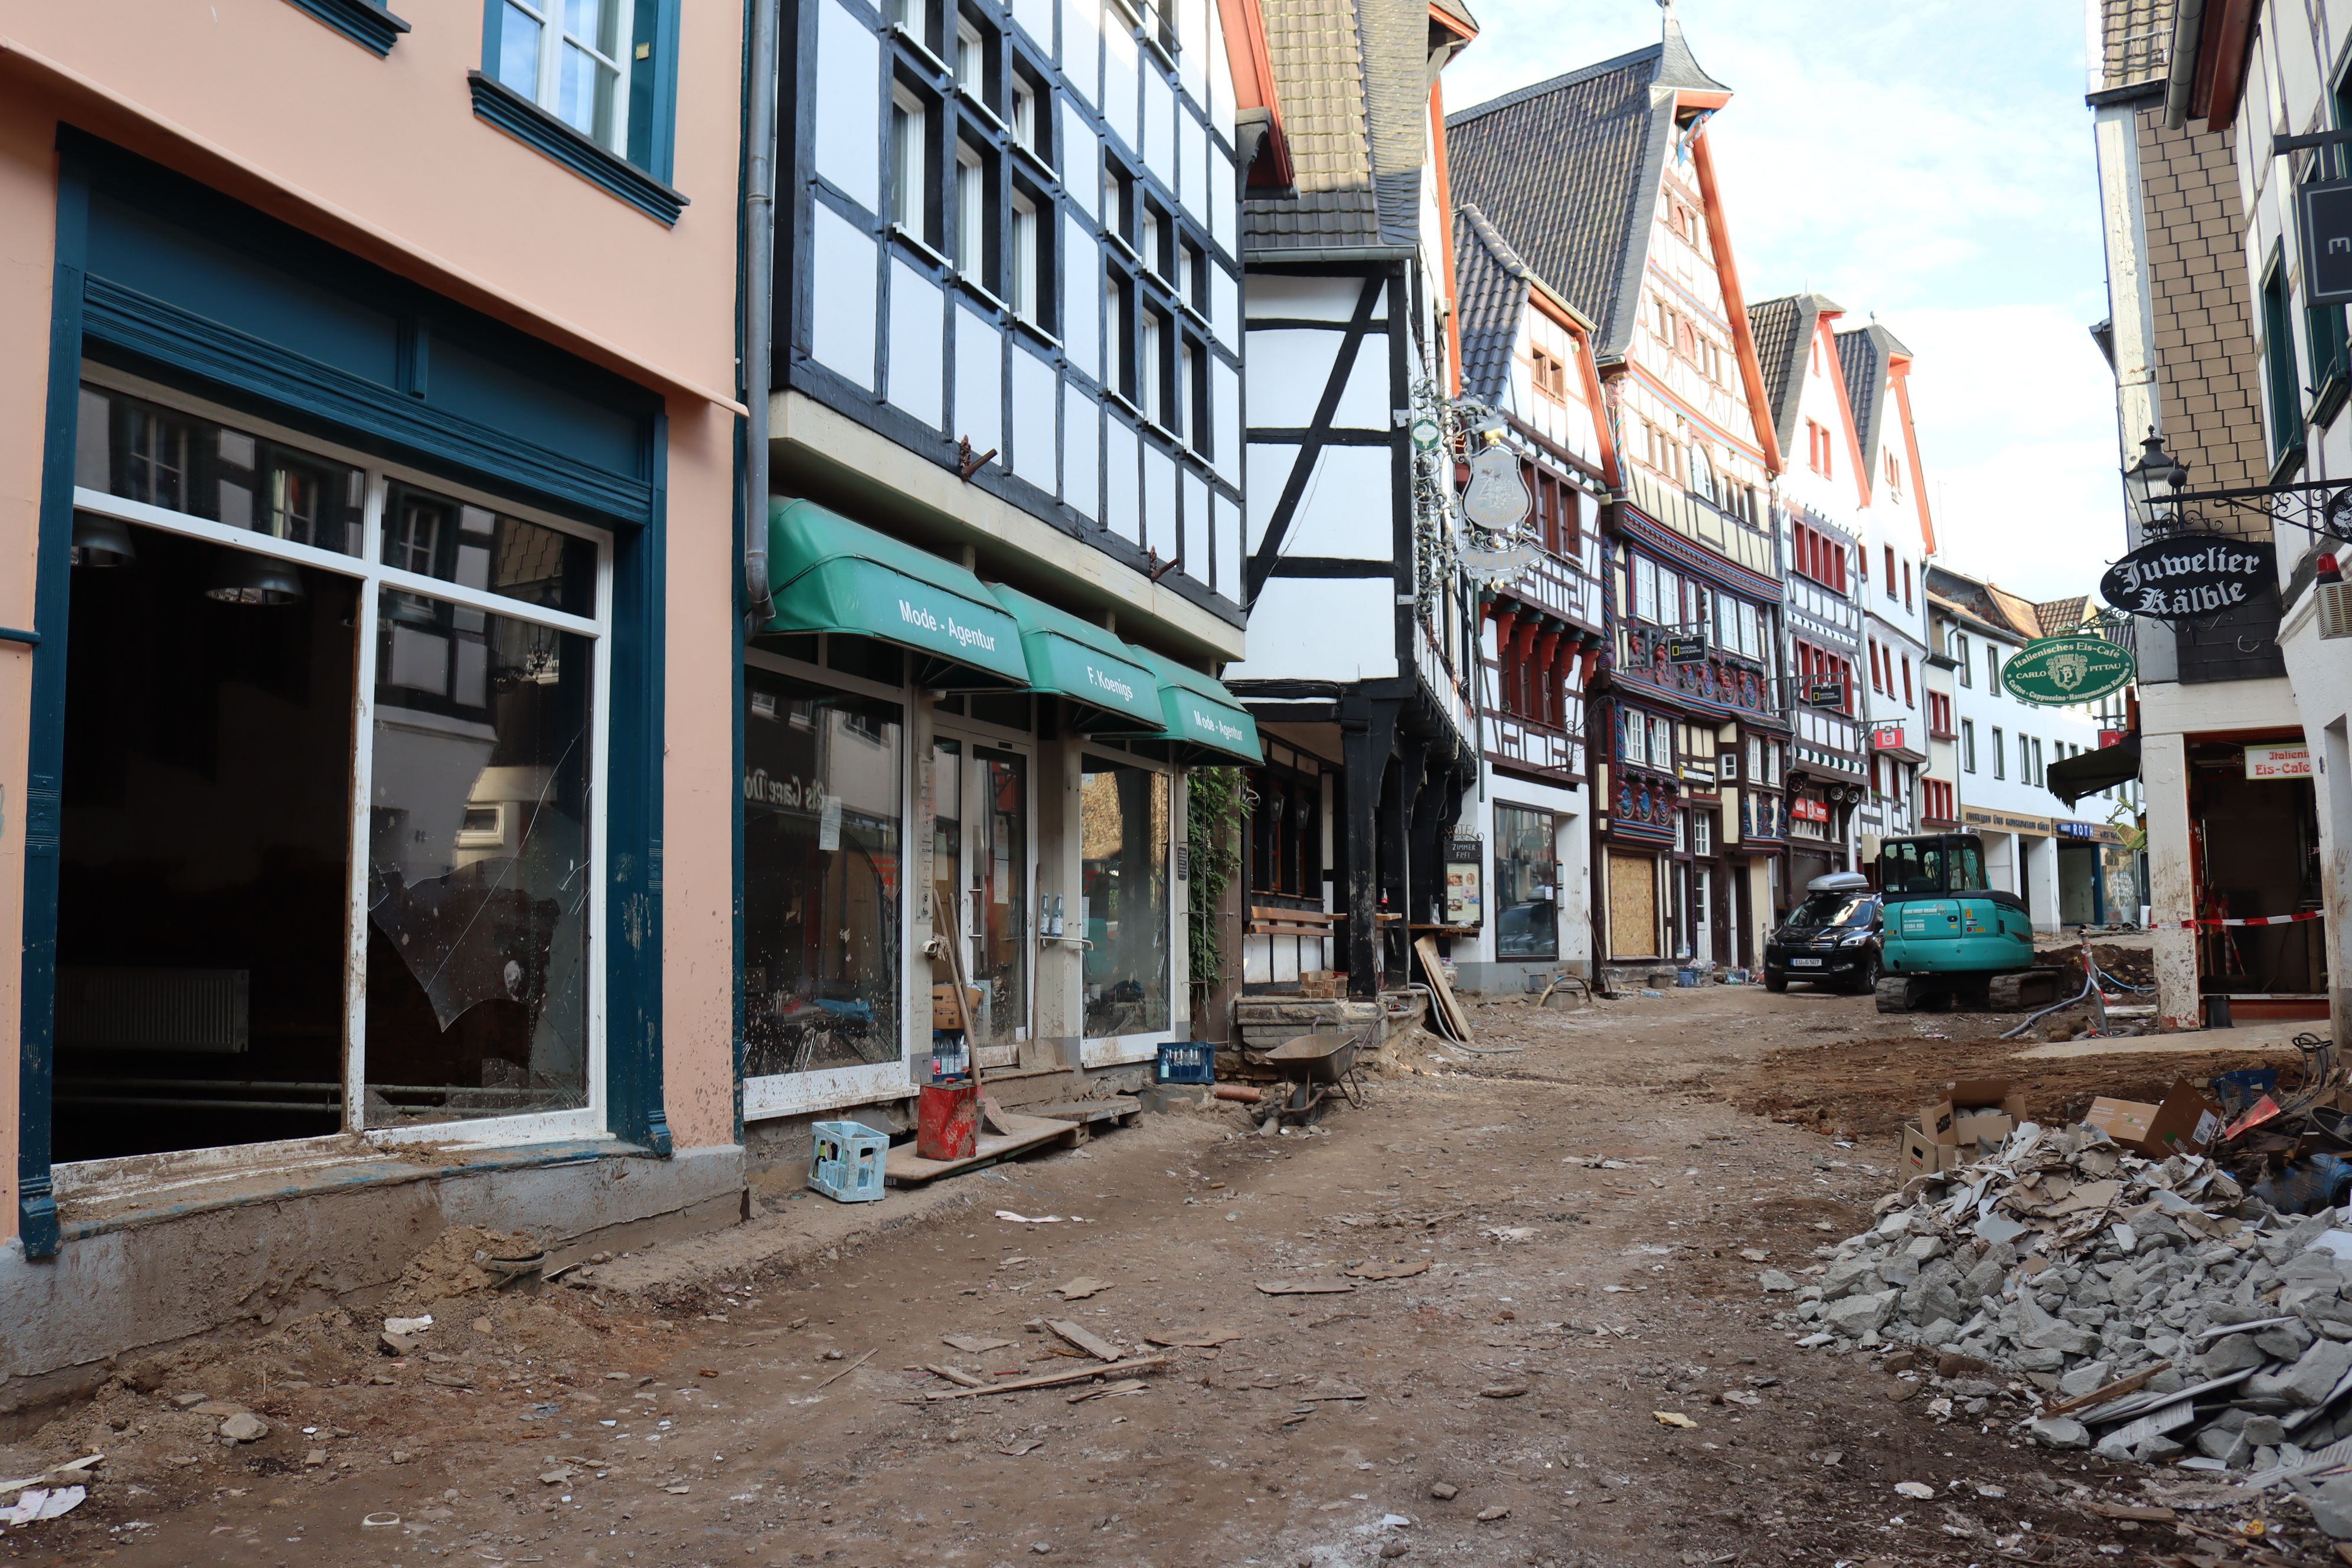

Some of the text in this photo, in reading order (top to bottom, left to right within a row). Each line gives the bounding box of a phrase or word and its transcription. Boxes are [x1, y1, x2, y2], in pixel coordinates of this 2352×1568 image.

[1466, 549, 1530, 567] HOTEL
[2113, 547, 2260, 596] Juwelier
[2132, 580, 2247, 615] Kälble
[899, 599, 937, 632] Mode
[948, 616, 995, 652] Agentur
[2013, 642, 2121, 669] Italienisches Eis-Café
[2089, 662, 2121, 672] PITTAU
[1096, 669, 1133, 702] Koenigs
[2008, 668, 2131, 701] Caffee Cappuccino Hausgemachte Kuchen
[2015, 670, 2047, 680] CARLO
[1194, 710, 1215, 731] Mode
[1219, 720, 1243, 741] Agentur
[1445, 824, 1476, 839] HOTEL
[2073, 824, 2093, 837] ROTH
